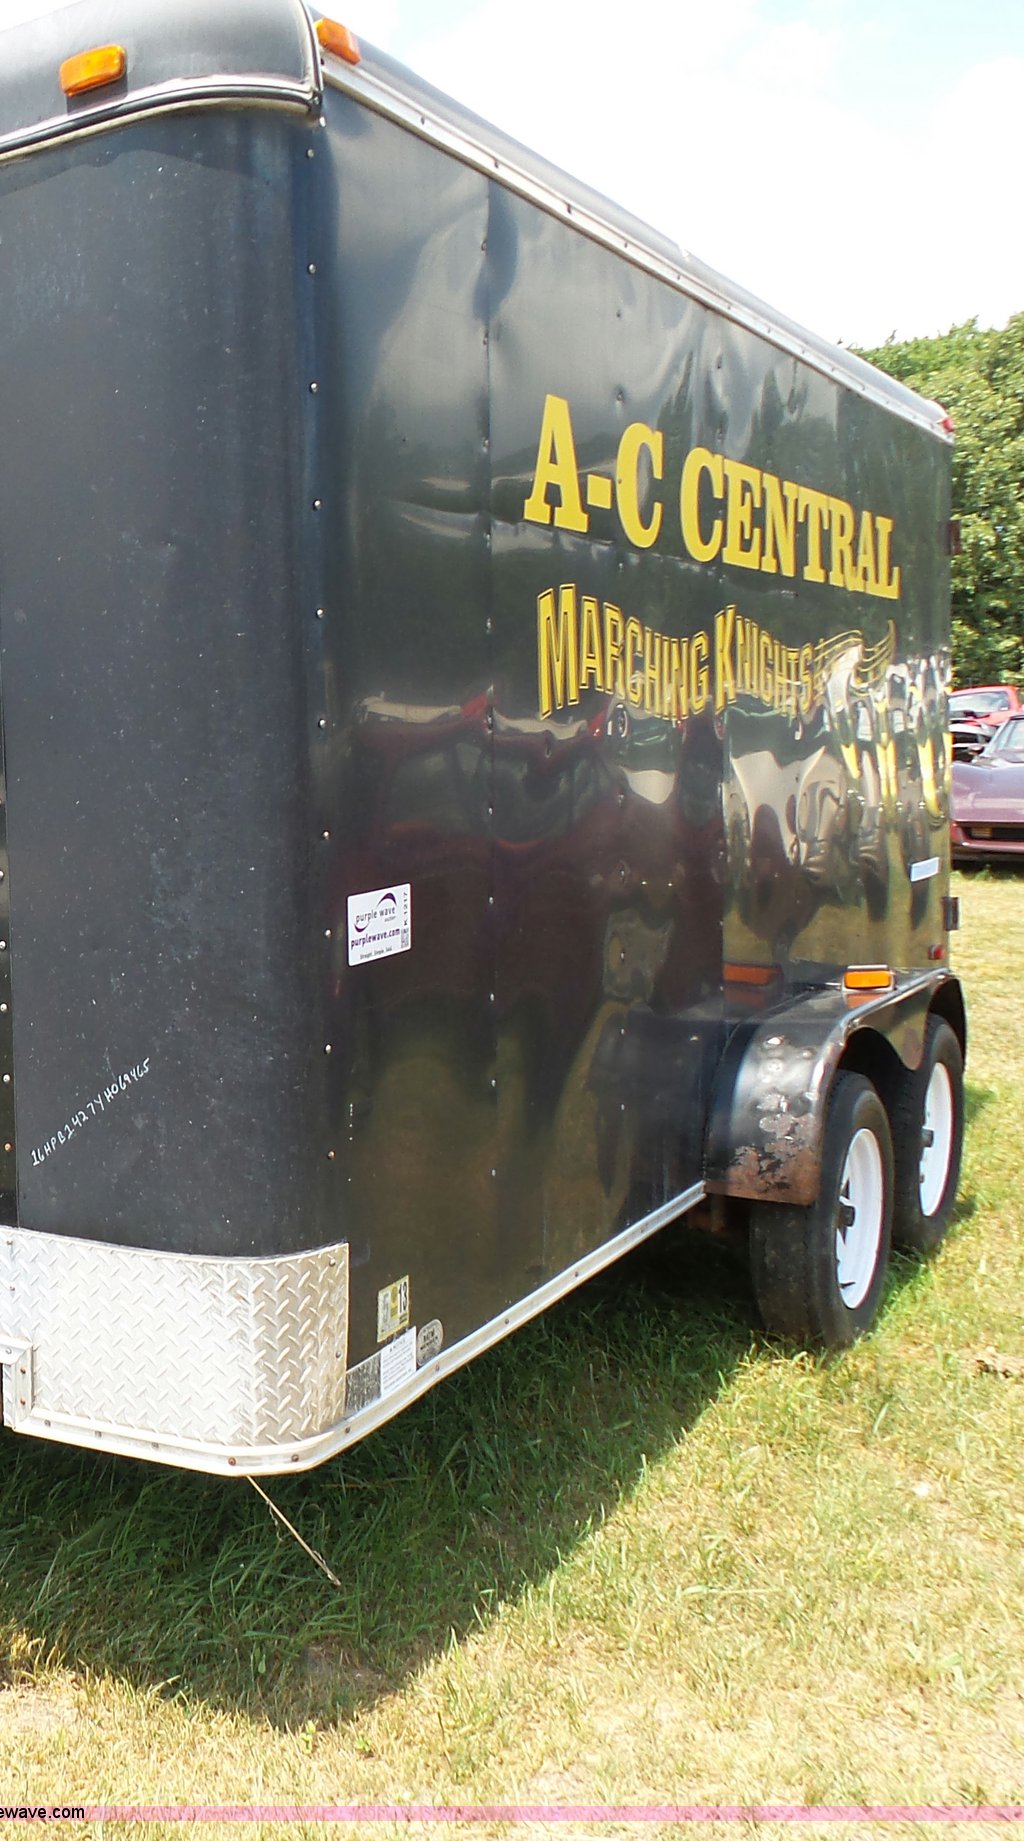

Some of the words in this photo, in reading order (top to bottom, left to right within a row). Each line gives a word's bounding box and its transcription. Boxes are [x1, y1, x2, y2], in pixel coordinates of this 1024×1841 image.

[523, 393, 664, 548] A-C
[680, 447, 901, 599] CENTRAL
[537, 582, 709, 721] MARCHING
[714, 603, 814, 718] KNIGHTS
[355, 909, 377, 924] purple
[379, 906, 396, 917] wave
[350, 928, 401, 950] purplewave.com
[398, 1281, 407, 1313] 13
